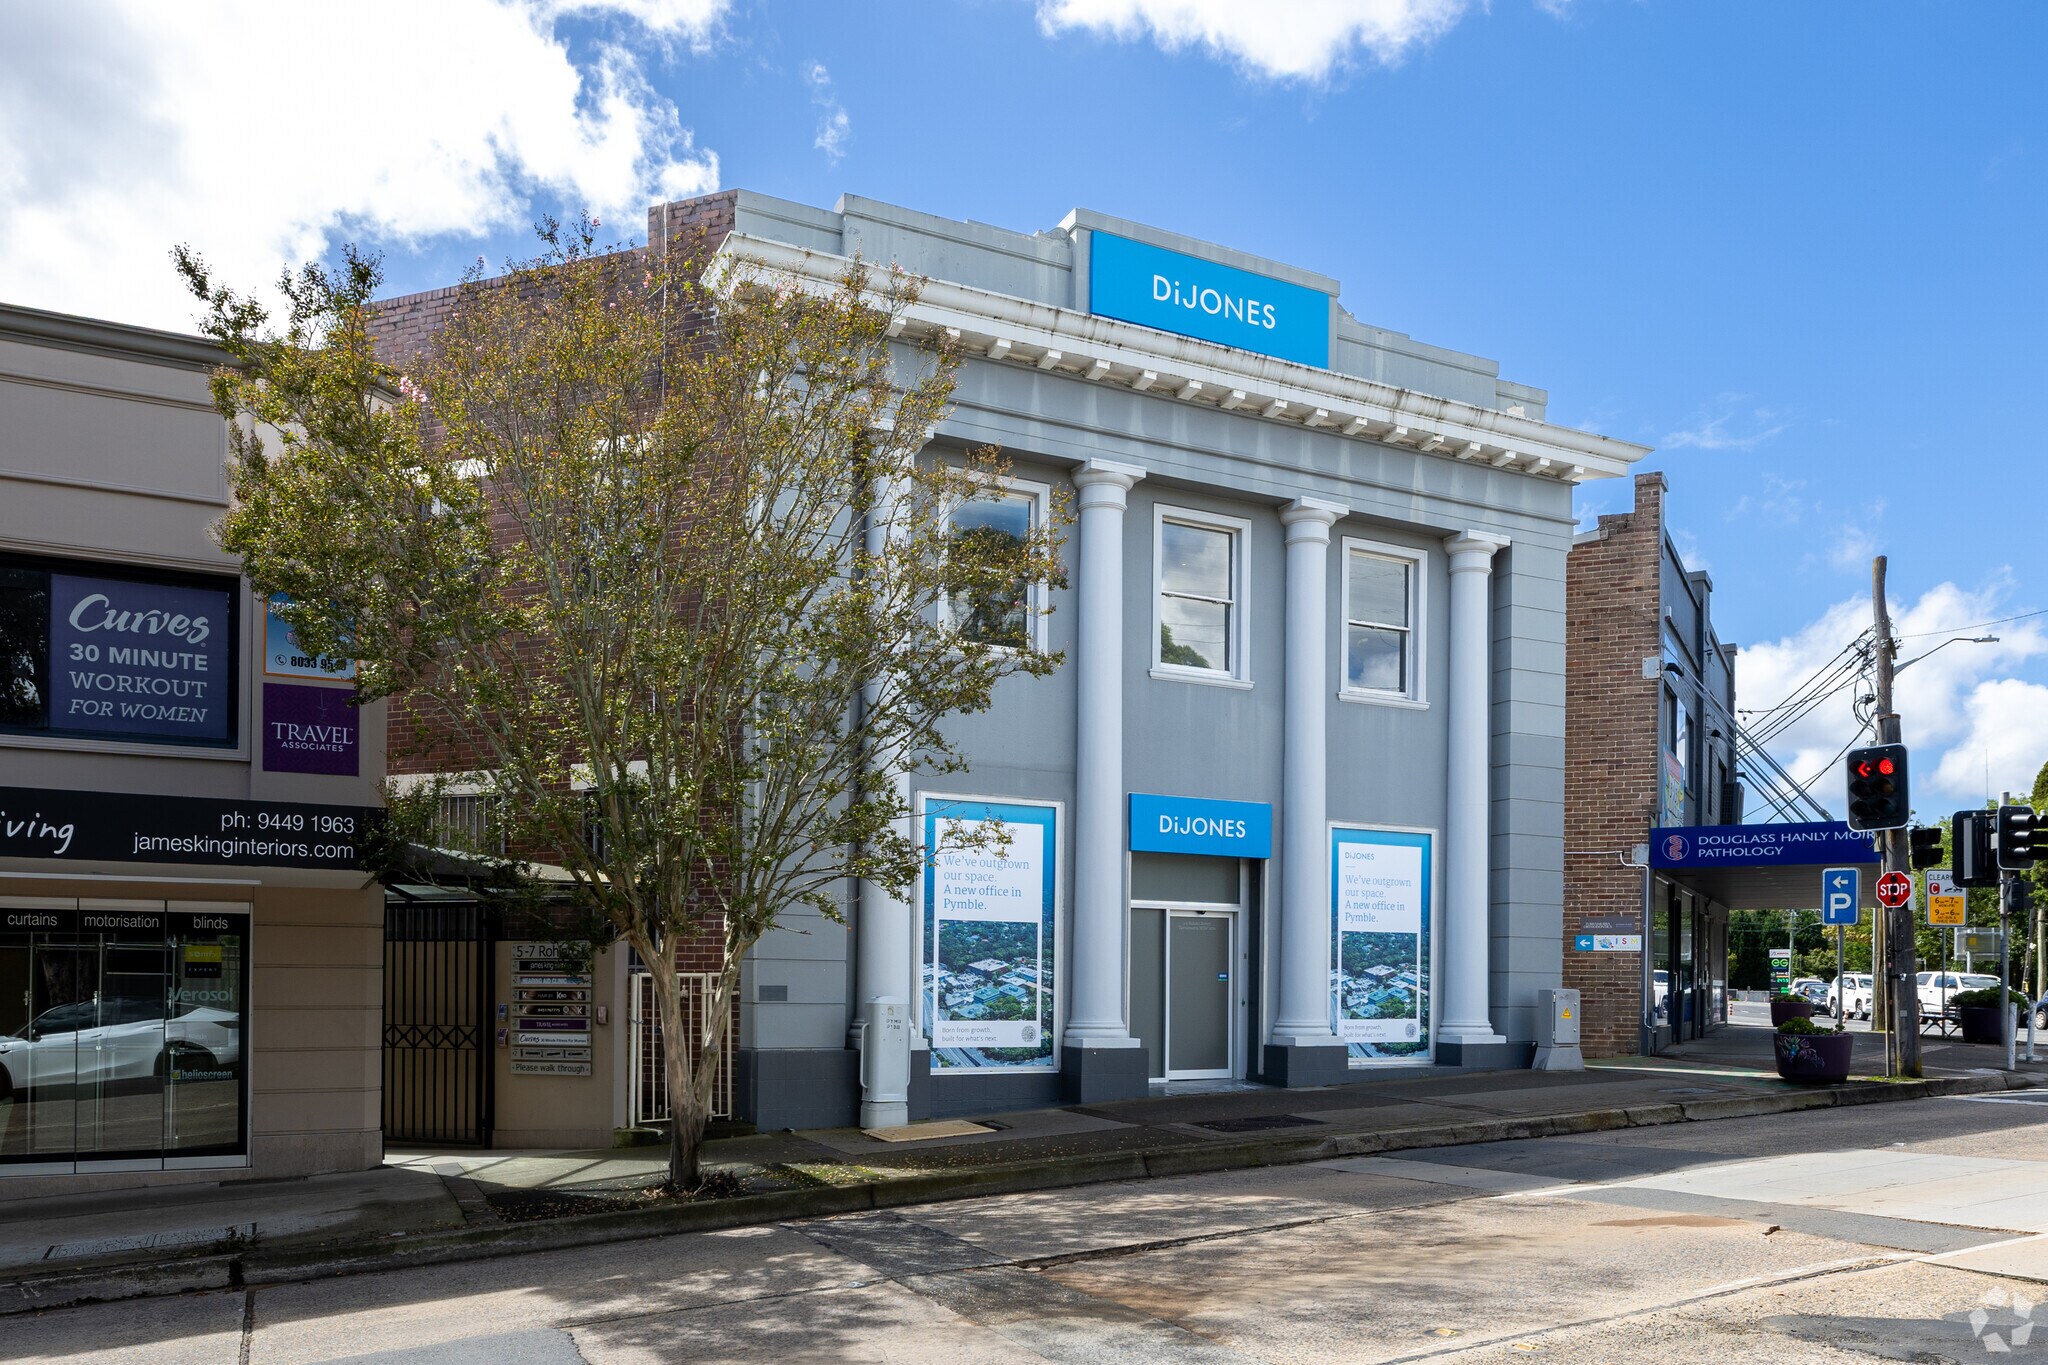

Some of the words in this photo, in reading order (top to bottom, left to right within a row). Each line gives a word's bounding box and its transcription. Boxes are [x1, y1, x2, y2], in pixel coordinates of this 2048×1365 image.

[1153, 274, 1276, 330] DiJONES
[69, 593, 210, 644] Curves
[69, 643, 100, 662] 30
[109, 646, 208, 671] MINUTE
[290, 655, 317, 669] 8033
[69, 671, 208, 698] WORKOUT
[68, 699, 114, 716] FOR
[120, 702, 208, 723] WOMEN
[271, 721, 353, 745] TRAVEL
[281, 741, 344, 753] ASSOCIATES
[220, 811, 250, 831] ph:
[258, 813, 304, 832] 9449
[311, 815, 355, 834] 1963
[1159, 814, 1247, 839] DiJONES
[133, 832, 354, 859] jameskinginteriors.com
[1698, 833, 1776, 846] DOUGLASS
[1781, 831, 1830, 842] HANLY
[1344, 851, 1375, 861] DiJONES
[1698, 846, 1784, 858] PATHOLOGY
[979, 857, 1030, 871] outgrown
[944, 871, 962, 881] our
[965, 873, 997, 884] space.
[1372, 876, 1412, 889] outgrown
[944, 885, 951, 895] A
[954, 886, 977, 896] new
[979, 885, 1009, 897] office
[1012, 886, 1022, 898] in
[1345, 889, 1359, 897] our
[1361, 890, 1386, 900] space.
[1880, 883, 1908, 896] STOP
[944, 898, 987, 912] Pymble.
[1345, 900, 1351, 909] A
[1353, 901, 1371, 910] new
[1372, 901, 1395, 911] office
[1397, 901, 1405, 911] in
[1830, 893, 1852, 919] P
[7, 913, 58, 927] curtains
[84, 915, 160, 929] motorisation
[193, 916, 229, 930] blinds
[1345, 912, 1378, 924] Pymble.
[170, 987, 233, 1002] Verosol
[182, 1069, 233, 1081] helioscreen
[515, 1063, 538, 1072] Please
[540, 1064, 556, 1072] walk
[557, 1064, 585, 1074] through
